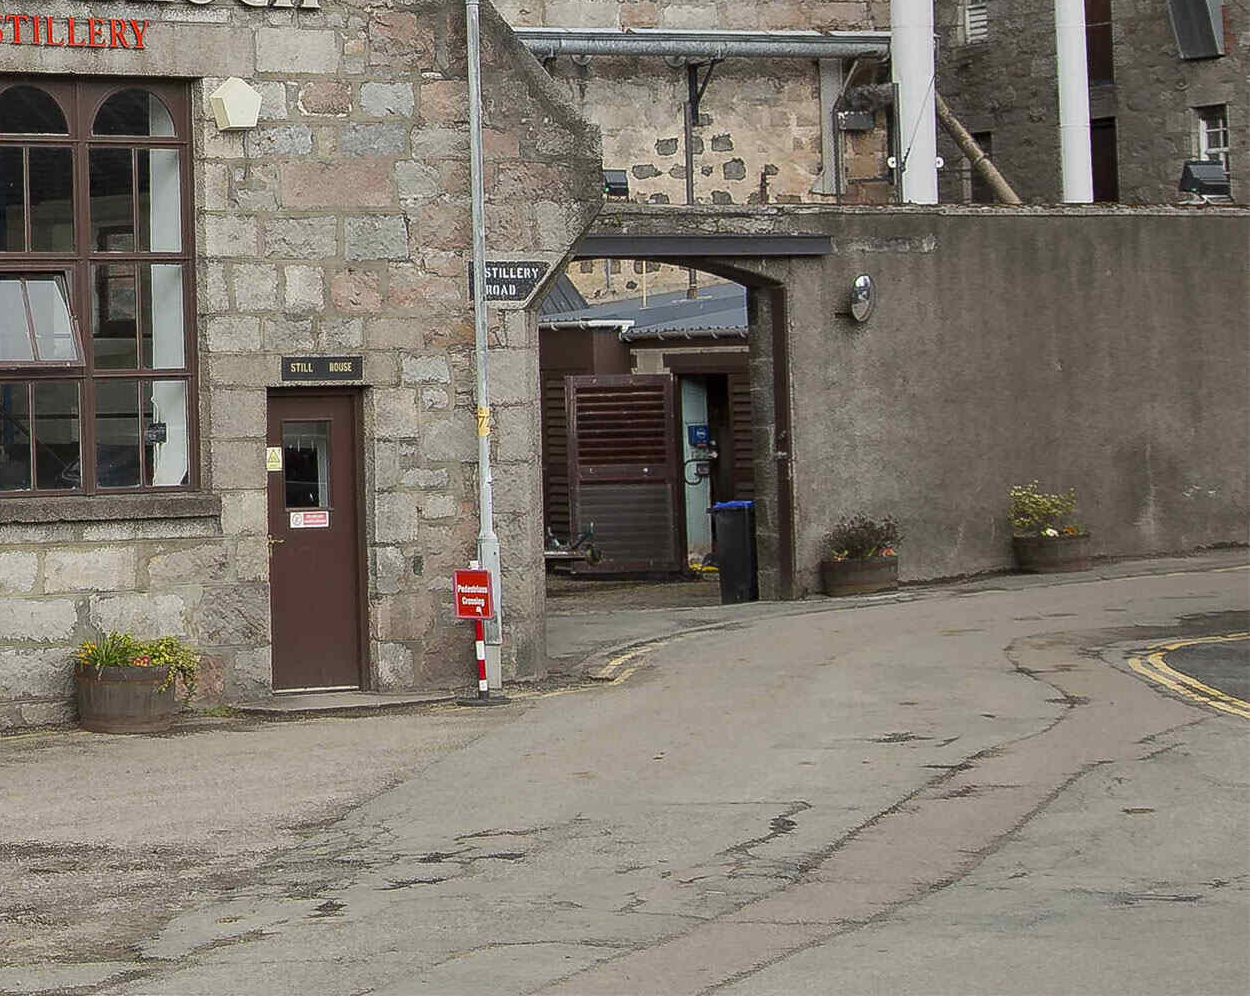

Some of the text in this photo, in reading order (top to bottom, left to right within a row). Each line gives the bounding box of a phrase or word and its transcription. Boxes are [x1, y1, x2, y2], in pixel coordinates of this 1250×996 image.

[485, 267, 539, 279] STILLERY
[485, 284, 517, 296] ROAD
[290, 362, 314, 373] STILL
